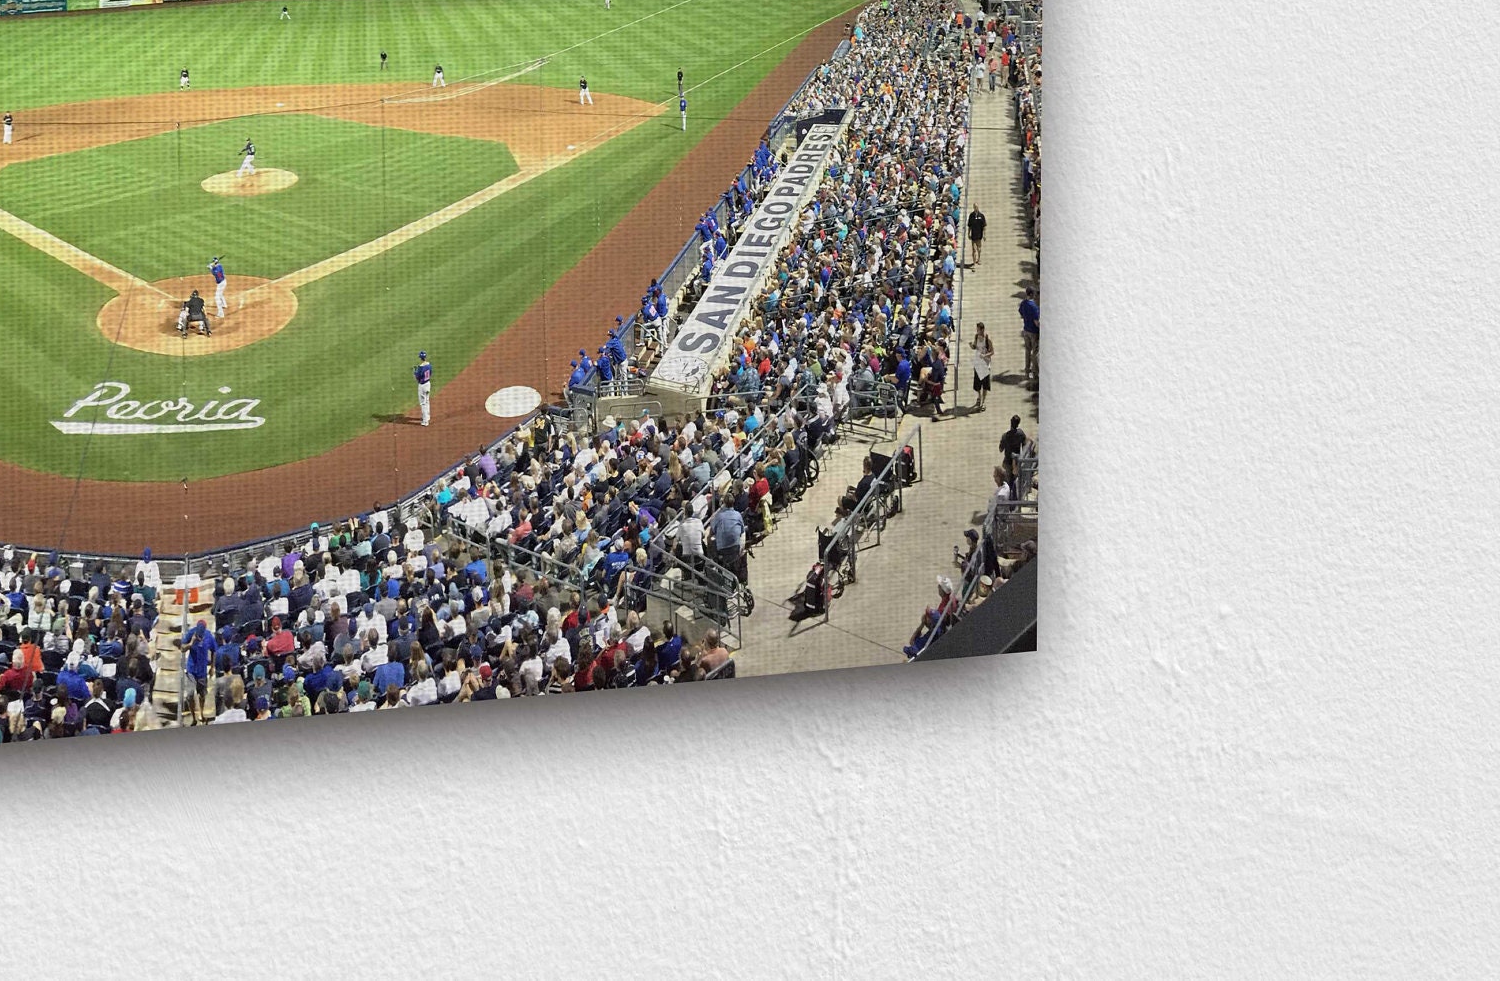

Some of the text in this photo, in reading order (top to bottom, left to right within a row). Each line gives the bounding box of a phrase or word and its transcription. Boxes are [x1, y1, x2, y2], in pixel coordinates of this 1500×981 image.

[677, 133, 830, 354] SAN DIEGO PADRES
[57, 382, 266, 427] Peoria
